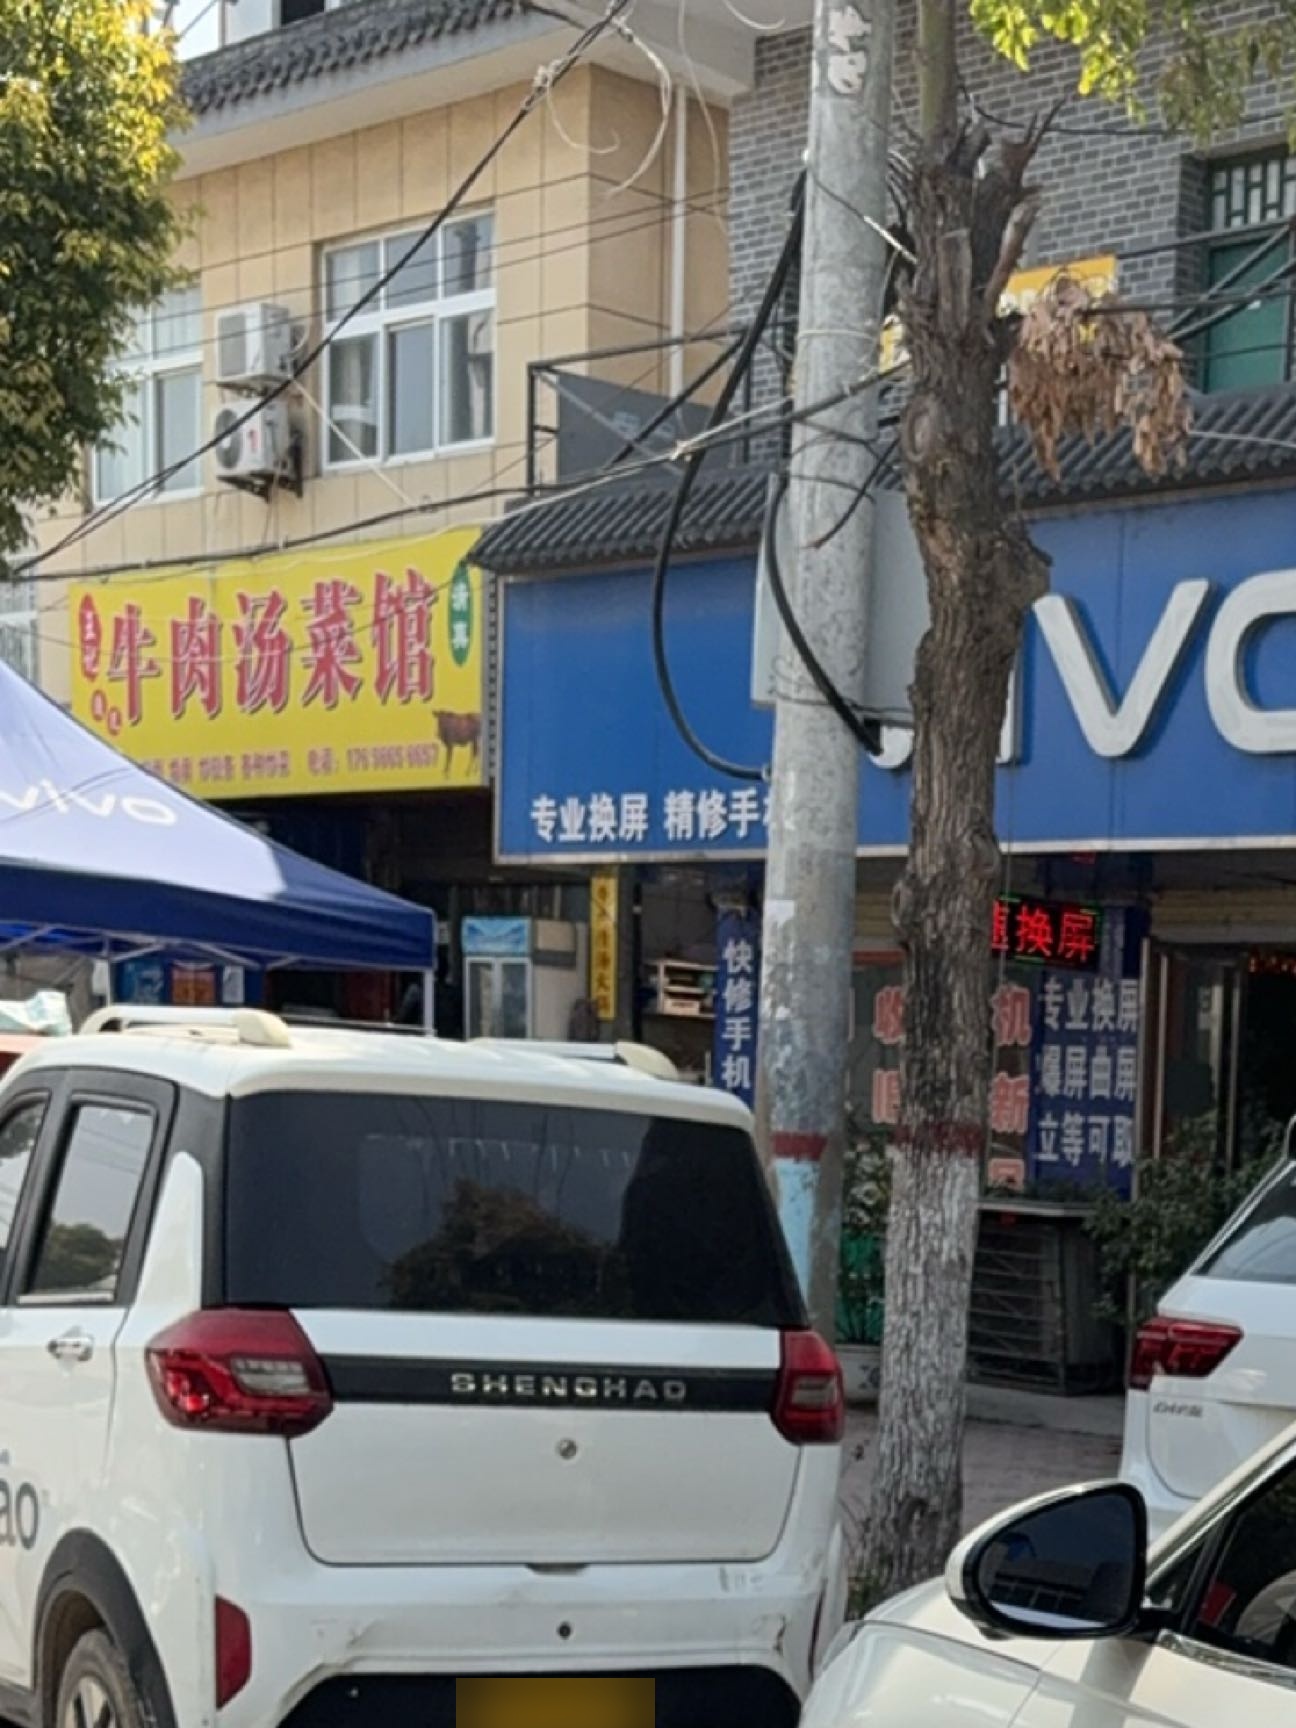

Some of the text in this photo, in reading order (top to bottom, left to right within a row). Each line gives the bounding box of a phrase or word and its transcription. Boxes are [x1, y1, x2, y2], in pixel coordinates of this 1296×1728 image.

[107, 568, 438, 727] 牛肉汤菜馆
[530, 785, 773, 843] 专业换屏 精修手
[720, 938, 754, 1090] 快修手机
[1039, 976, 1139, 1033] 专业换屏
[1033, 1110, 1134, 1168] 立等可取
[451, 1373, 687, 1400] SHENGHAO
